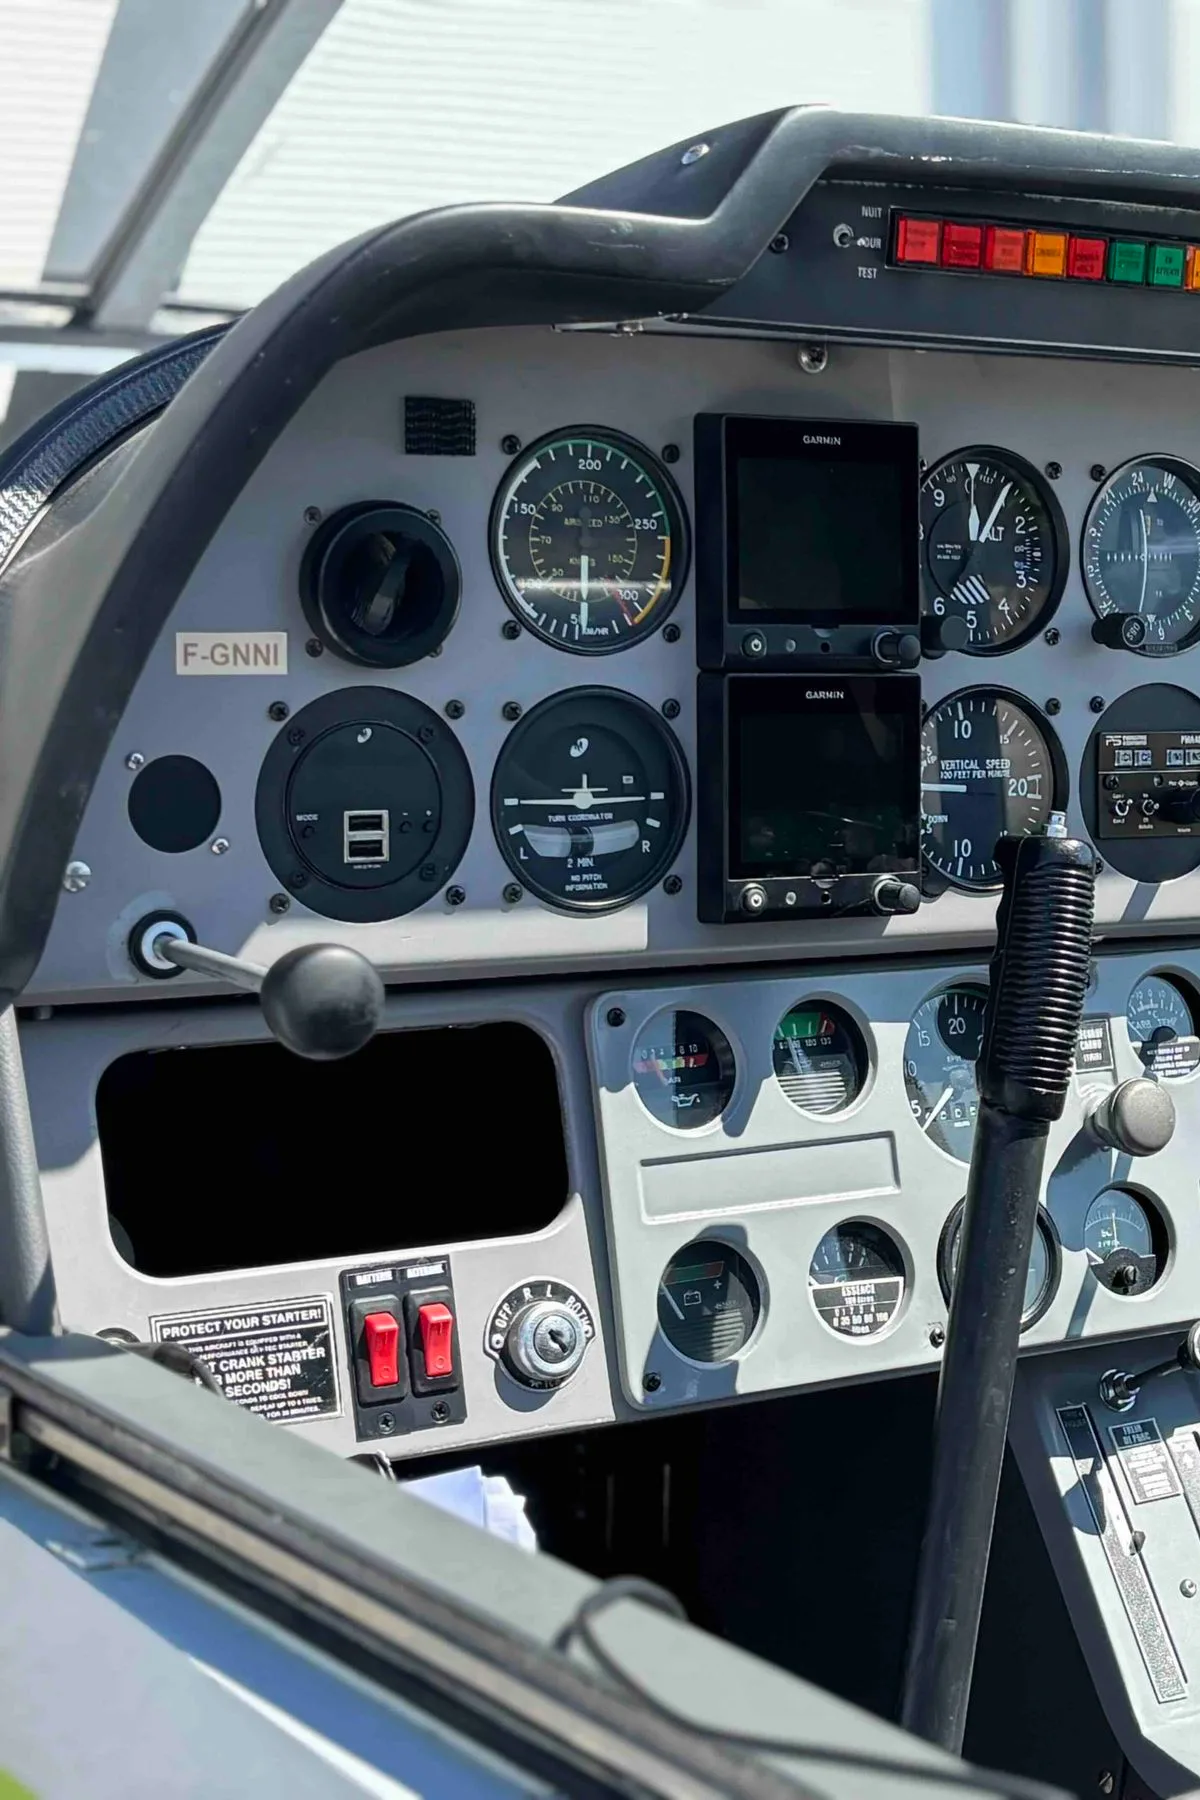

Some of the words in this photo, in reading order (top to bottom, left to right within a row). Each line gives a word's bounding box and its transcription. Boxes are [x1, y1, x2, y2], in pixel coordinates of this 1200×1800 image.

[861, 205, 882, 218] NUIT
[858, 266, 877, 279] TEST
[803, 434, 841, 446] GARMIN
[578, 459, 602, 471] 200
[1131, 471, 1143, 483] 24
[1163, 472, 1176, 489] W
[933, 488, 945, 507] 9
[1187, 495, 1200, 513] 30
[514, 503, 536, 516] 150
[634, 518, 658, 531] 250
[1015, 515, 1026, 534] 2
[1016, 570, 1027, 589] 3
[933, 596, 946, 616] 6
[998, 597, 1010, 614] 4
[966, 610, 978, 629] 5
[183, 642, 279, 666] F-GNNI
[805, 689, 845, 700] GARMIN
[954, 720, 972, 739] 10
[1000, 735, 1010, 745] 15
[940, 759, 980, 770] VERTICAL
[985, 759, 1011, 770] SPEED
[1008, 779, 1028, 797] 20
[928, 814, 949, 824] DOWN
[642, 840, 651, 852] R
[954, 838, 972, 858] 10
[519, 847, 528, 860] L
[567, 858, 573, 868] 2
[571, 874, 580, 882] NO
[582, 873, 602, 881] PITCH
[565, 882, 608, 892] INFORMATION
[948, 1017, 966, 1035] 20
[918, 1030, 930, 1047] 15
[689, 1044, 698, 1053] 10
[904, 1060, 917, 1077] 10
[911, 1099, 921, 1117] 5
[523, 1287, 533, 1300] R
[546, 1284, 553, 1298] L
[495, 1302, 513, 1329] OFF
[565, 1295, 589, 1323] BOTH
[162, 1321, 221, 1339] PROTECT
[224, 1317, 260, 1332] YOUR
[262, 1308, 321, 1326] STARTER!
[205, 1341, 236, 1352] AIRCRAFT
[245, 1335, 278, 1347] EQUIPPED
[279, 1334, 295, 1342] WITH
[219, 1354, 265, 1371] CRANK
[267, 1347, 325, 1365] STARTER
[225, 1369, 263, 1384] MORE
[266, 1362, 301, 1378] THAN
[225, 1379, 291, 1398] SECONDS!
[269, 1393, 287, 1401] COOL
[288, 1389, 309, 1399] DOWN
[251, 1402, 276, 1412] REPEAT
[267, 1410, 281, 1418] FOR
[1122, 1424, 1142, 1434] FREIN
[1132, 1432, 1151, 1444] PARC
